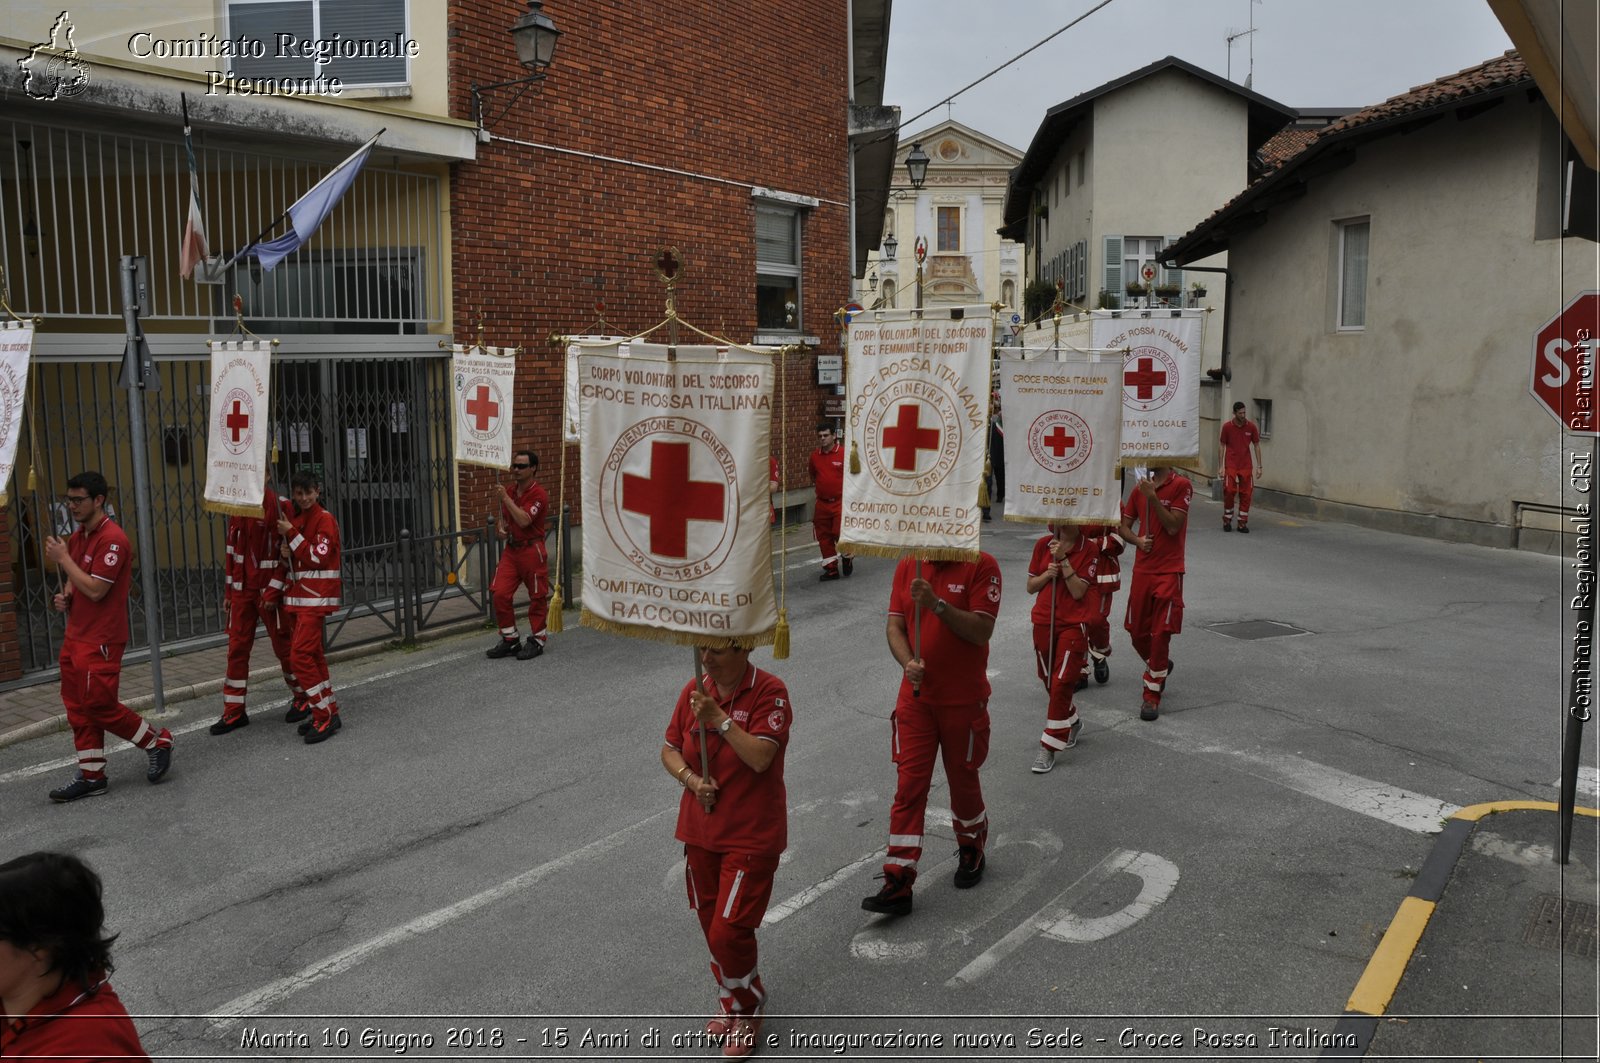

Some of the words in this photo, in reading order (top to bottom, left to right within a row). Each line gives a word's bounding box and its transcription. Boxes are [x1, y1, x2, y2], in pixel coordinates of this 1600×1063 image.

[925, 328, 941, 339] DEL
[1105, 333, 1126, 348] ROCE
[1128, 327, 1155, 337] ROSSA
[1158, 329, 1188, 354] ITALIANA
[1132, 349, 1161, 358] GINEVRA
[471, 367, 491, 375] ROSSA
[591, 366, 621, 382] CORPO
[683, 374, 705, 389] DEL
[1013, 374, 1041, 384] CROCE
[1043, 375, 1070, 384] ROSSA
[1073, 376, 1108, 385] ITALIANA
[581, 384, 635, 405] CROCE
[642, 392, 694, 408] ROSSA
[700, 394, 770, 411] ITALIANA
[850, 376, 878, 428] CROCE
[879, 358, 931, 381] ROSSA
[935, 363, 984, 431] ITALIANA
[880, 394, 891, 407] DI
[893, 383, 944, 406] GINEVRA
[942, 405, 953, 421] 22
[1123, 420, 1148, 428] ITATO
[608, 420, 676, 472] CONVENZIONE
[682, 421, 698, 434] DI
[701, 430, 737, 485] GINEVRA
[939, 425, 958, 470] AGOSTO
[1121, 442, 1170, 451] DRONERO
[219, 486, 247, 498] BUSCA
[1019, 484, 1088, 496] DELEGAZIONE
[1093, 488, 1103, 496] DI
[1042, 497, 1077, 506] BARGE
[850, 502, 898, 515] COMITATO
[903, 504, 951, 518] LOCALE
[956, 508, 968, 519] DI
[844, 516, 880, 529] BORGO
[885, 520, 893, 531] S.
[898, 521, 975, 537] DALMAZZO
[591, 574, 663, 598] COMITATO
[669, 588, 730, 607] LOCALE
[736, 592, 753, 607] DI
[611, 601, 731, 629] RACCONIGI
